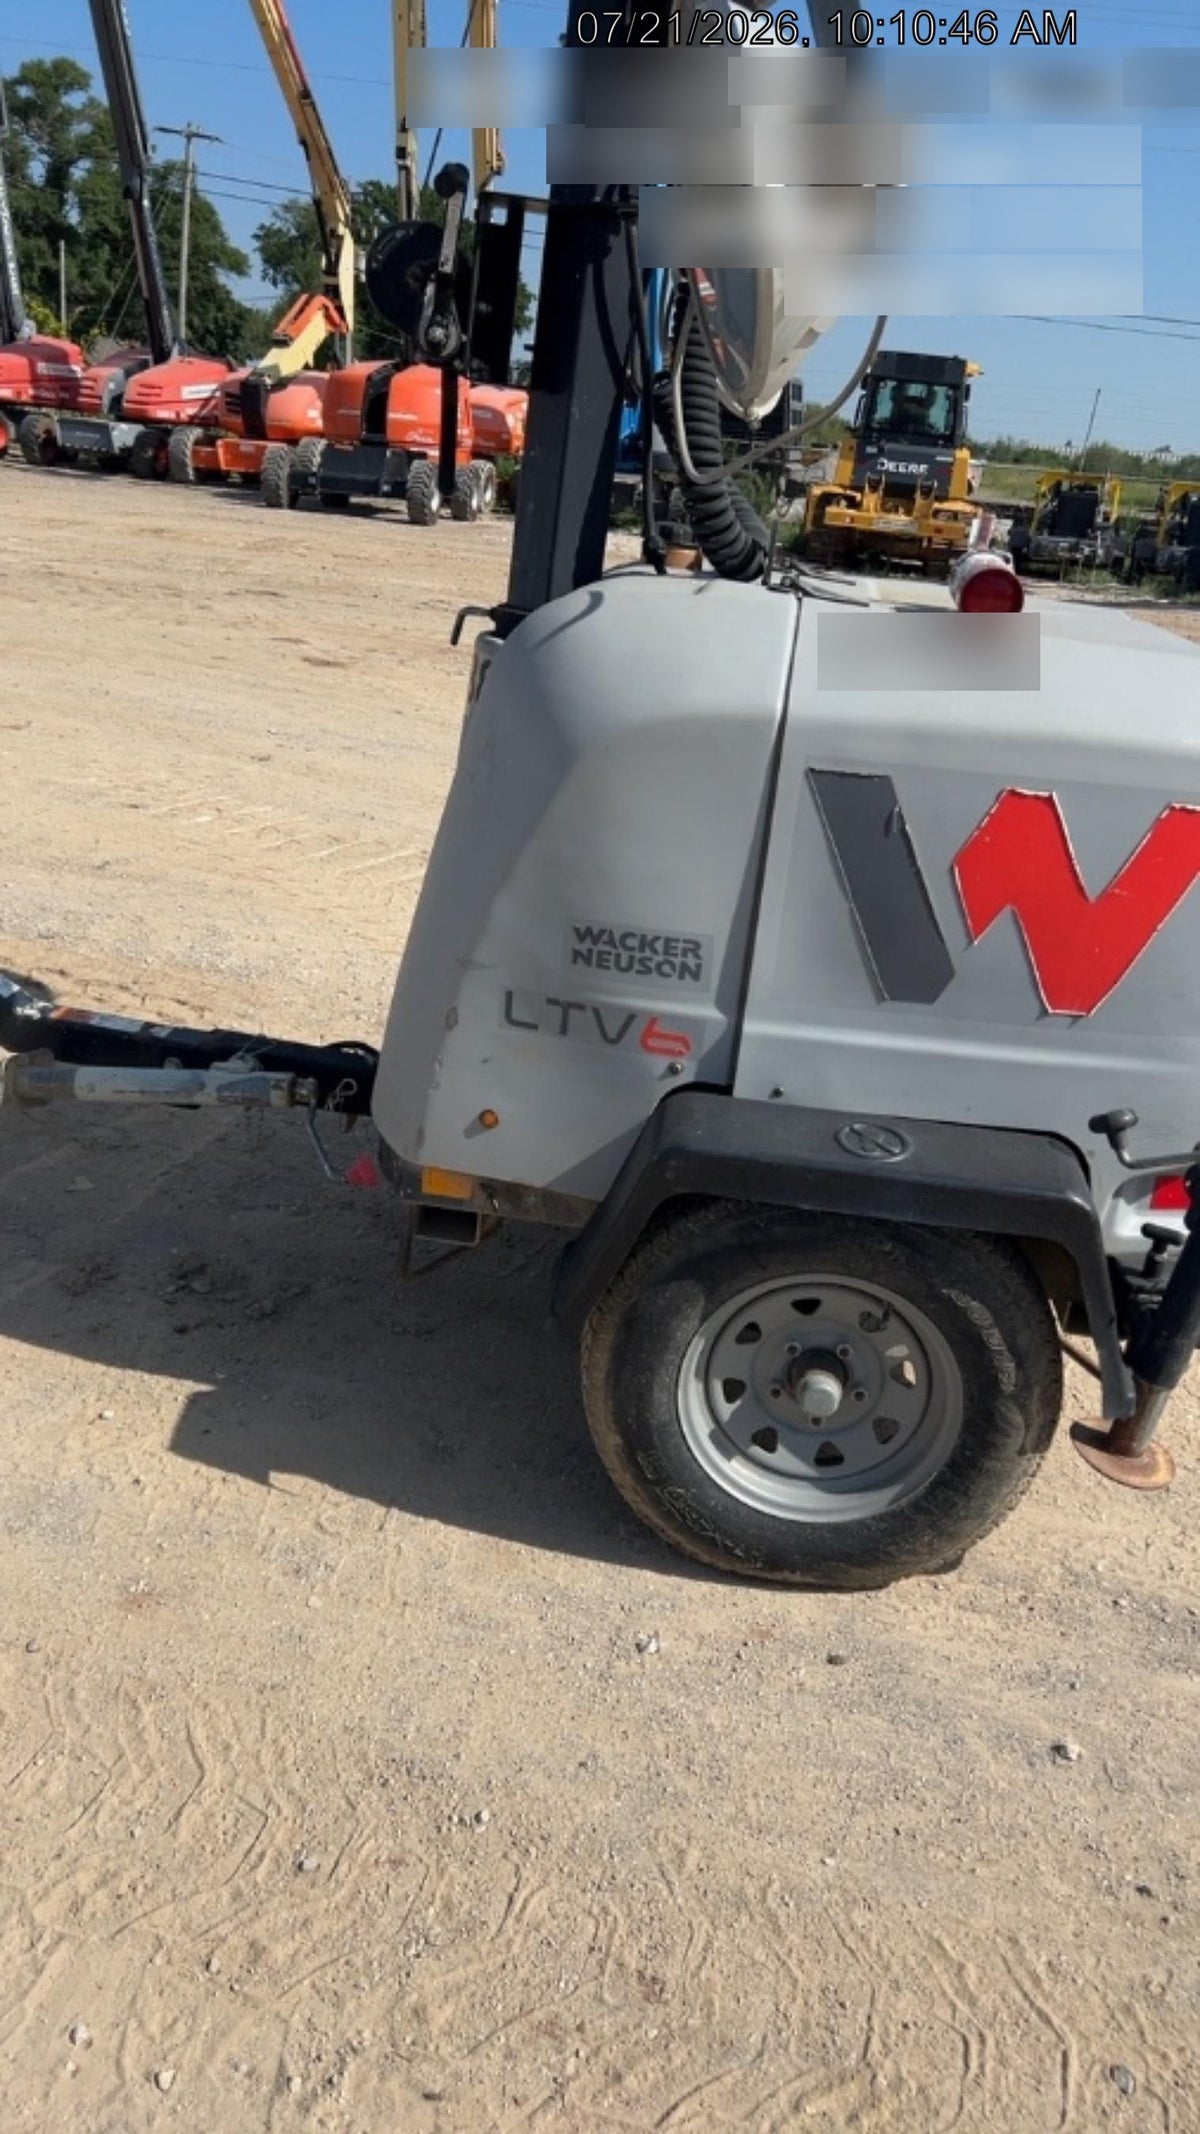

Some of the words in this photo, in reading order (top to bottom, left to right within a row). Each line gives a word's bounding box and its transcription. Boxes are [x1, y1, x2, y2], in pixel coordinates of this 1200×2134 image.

[877, 457, 929, 474] DEERE
[573, 926, 703, 961] WACKER
[572, 948, 703, 982] NEUSON
